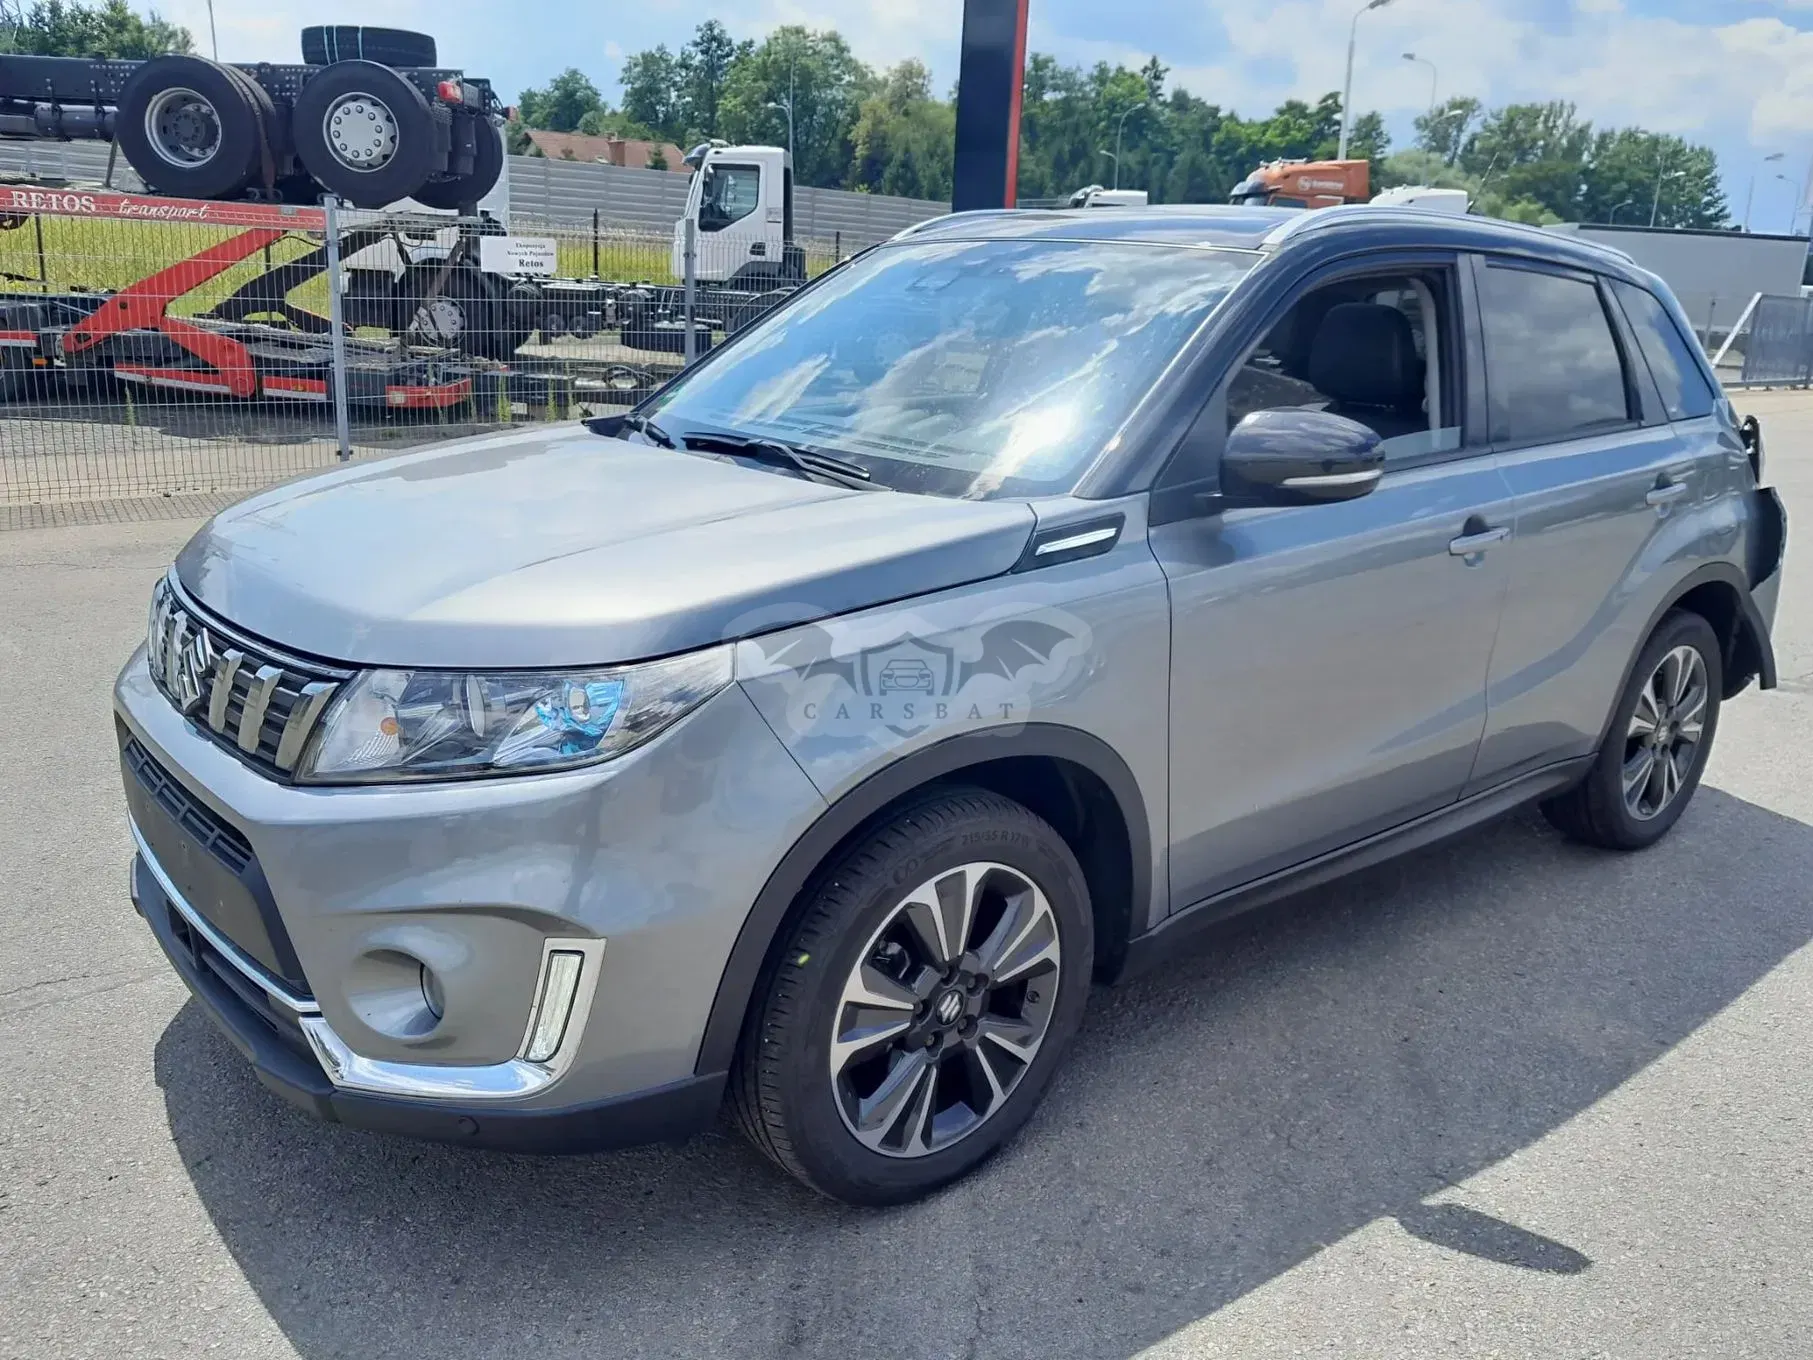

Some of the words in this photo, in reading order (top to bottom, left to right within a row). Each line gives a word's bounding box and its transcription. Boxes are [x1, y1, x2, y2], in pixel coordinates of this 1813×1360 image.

[11, 190, 96, 213] RETOS
[119, 198, 210, 220] transport
[518, 259, 544, 267] Retos
